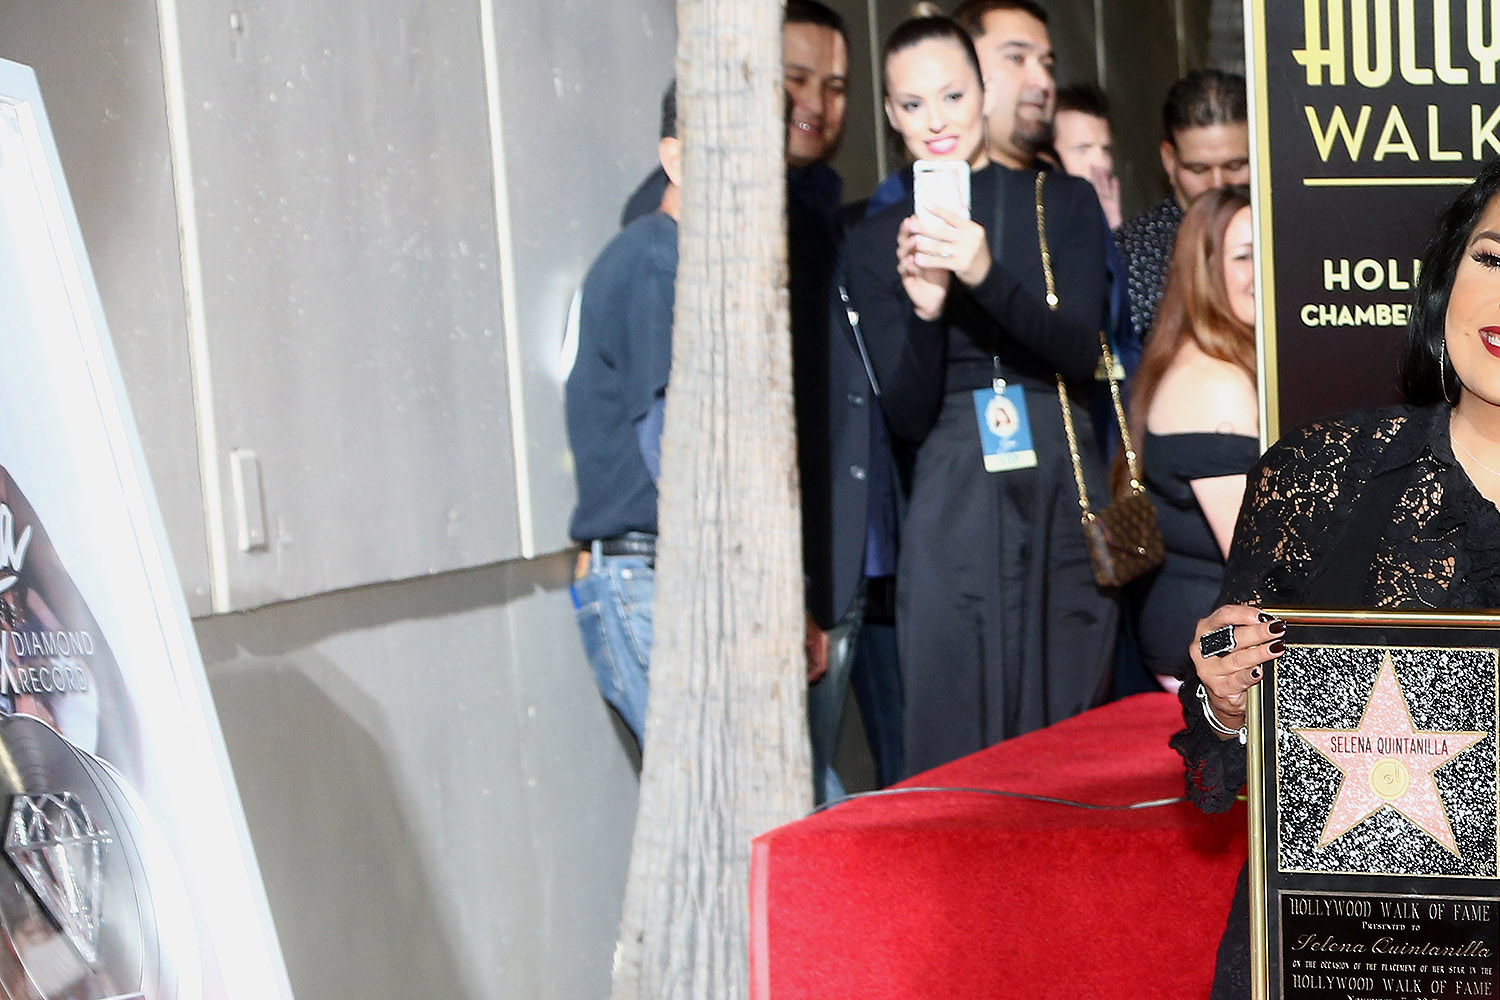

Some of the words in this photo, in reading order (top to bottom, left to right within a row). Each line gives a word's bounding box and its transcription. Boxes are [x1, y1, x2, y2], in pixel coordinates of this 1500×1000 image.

[1300, 303, 1412, 327] CHAMBE
[11, 631, 95, 657] DIAMOND
[18, 667, 90, 694] RECORD
[1330, 735, 1373, 754] SELENA
[1377, 737, 1449, 756] QUINTANILLA
[1289, 897, 1373, 917] HOLLYWOOD
[1380, 901, 1421, 920] WALK
[1428, 903, 1446, 920] OF
[1453, 904, 1490, 922] FAME
[1291, 933, 1368, 953] Selena
[1371, 936, 1494, 958] Quintanilla
[1305, 960, 1317, 969] THE
[1353, 962, 1362, 970] OF
[1366, 963, 1378, 971] THE
[1381, 963, 1416, 973] PLACEMENT
[1420, 965, 1429, 973] OF
[1481, 967, 1493, 976] THE
[1292, 973, 1375, 991] HOLLYWOOD
[1382, 977, 1422, 994] WALK
[1430, 979, 1447, 994] OF
[1455, 980, 1492, 996] FAME
